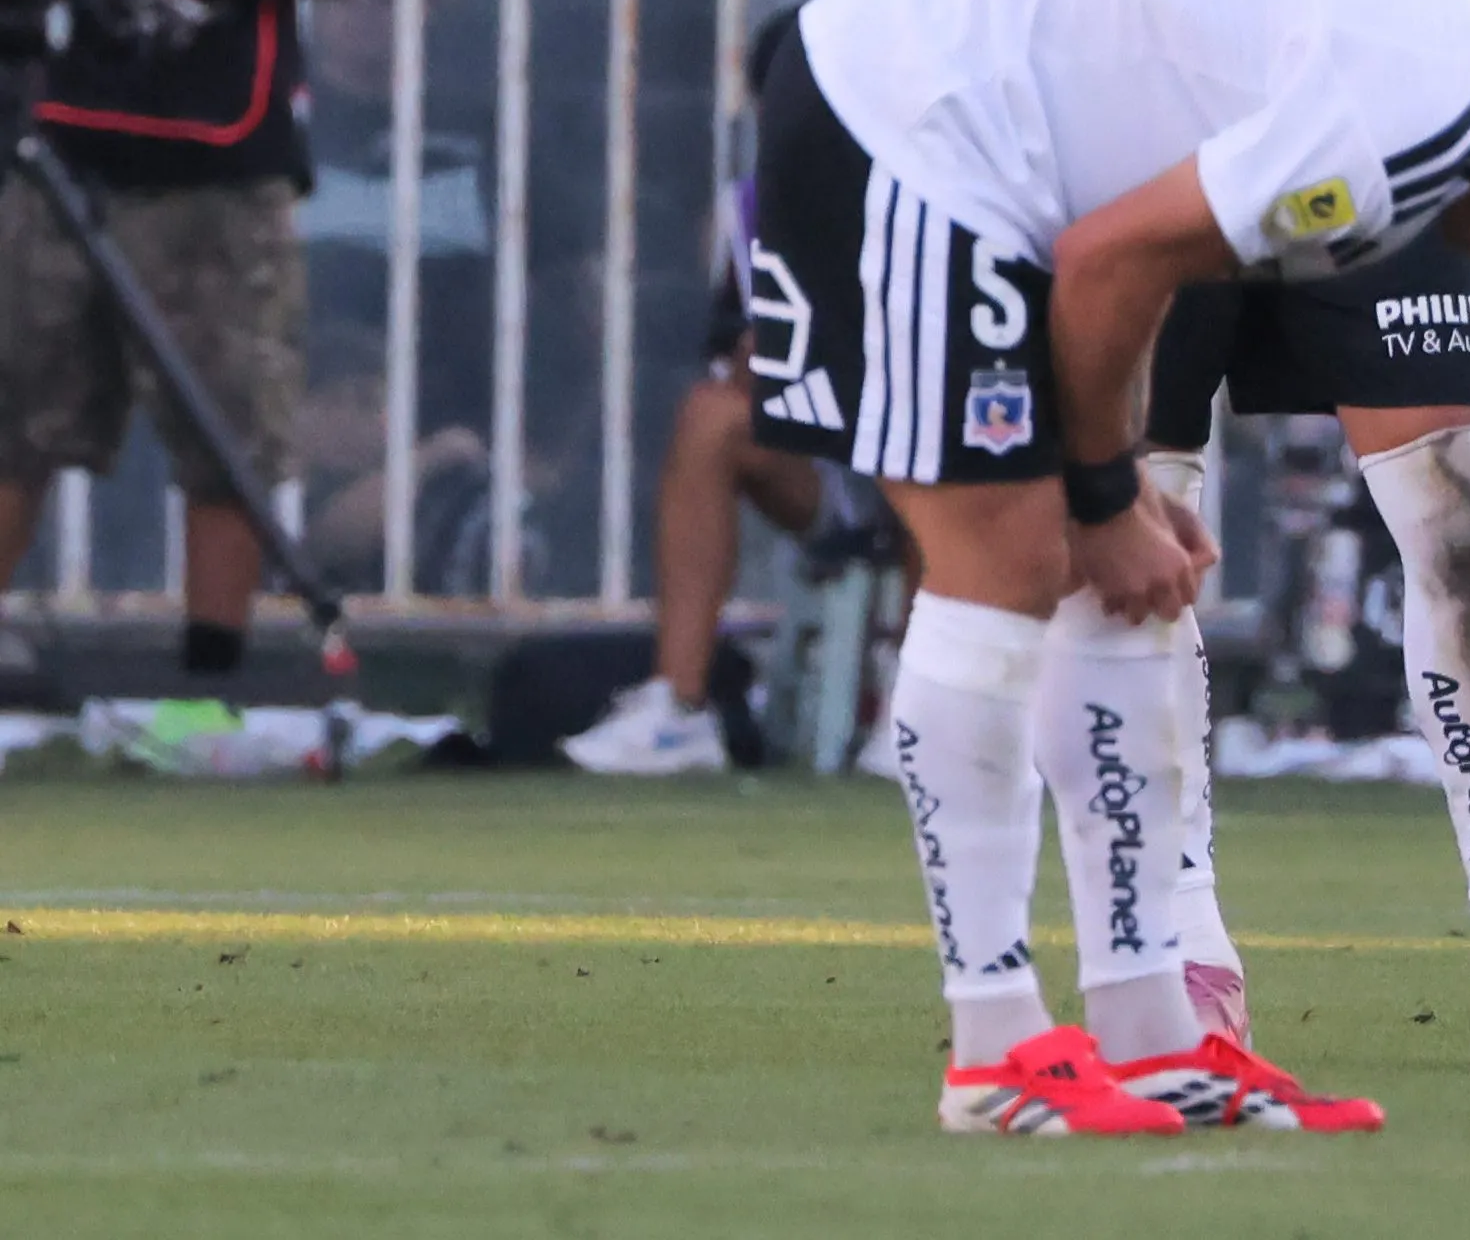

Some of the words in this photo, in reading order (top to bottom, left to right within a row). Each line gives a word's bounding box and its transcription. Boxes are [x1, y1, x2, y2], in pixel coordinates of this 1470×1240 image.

[1382, 331, 1415, 358] TV
[1422, 328, 1441, 354] &
[1084, 702, 1148, 954] AutoPlanet
